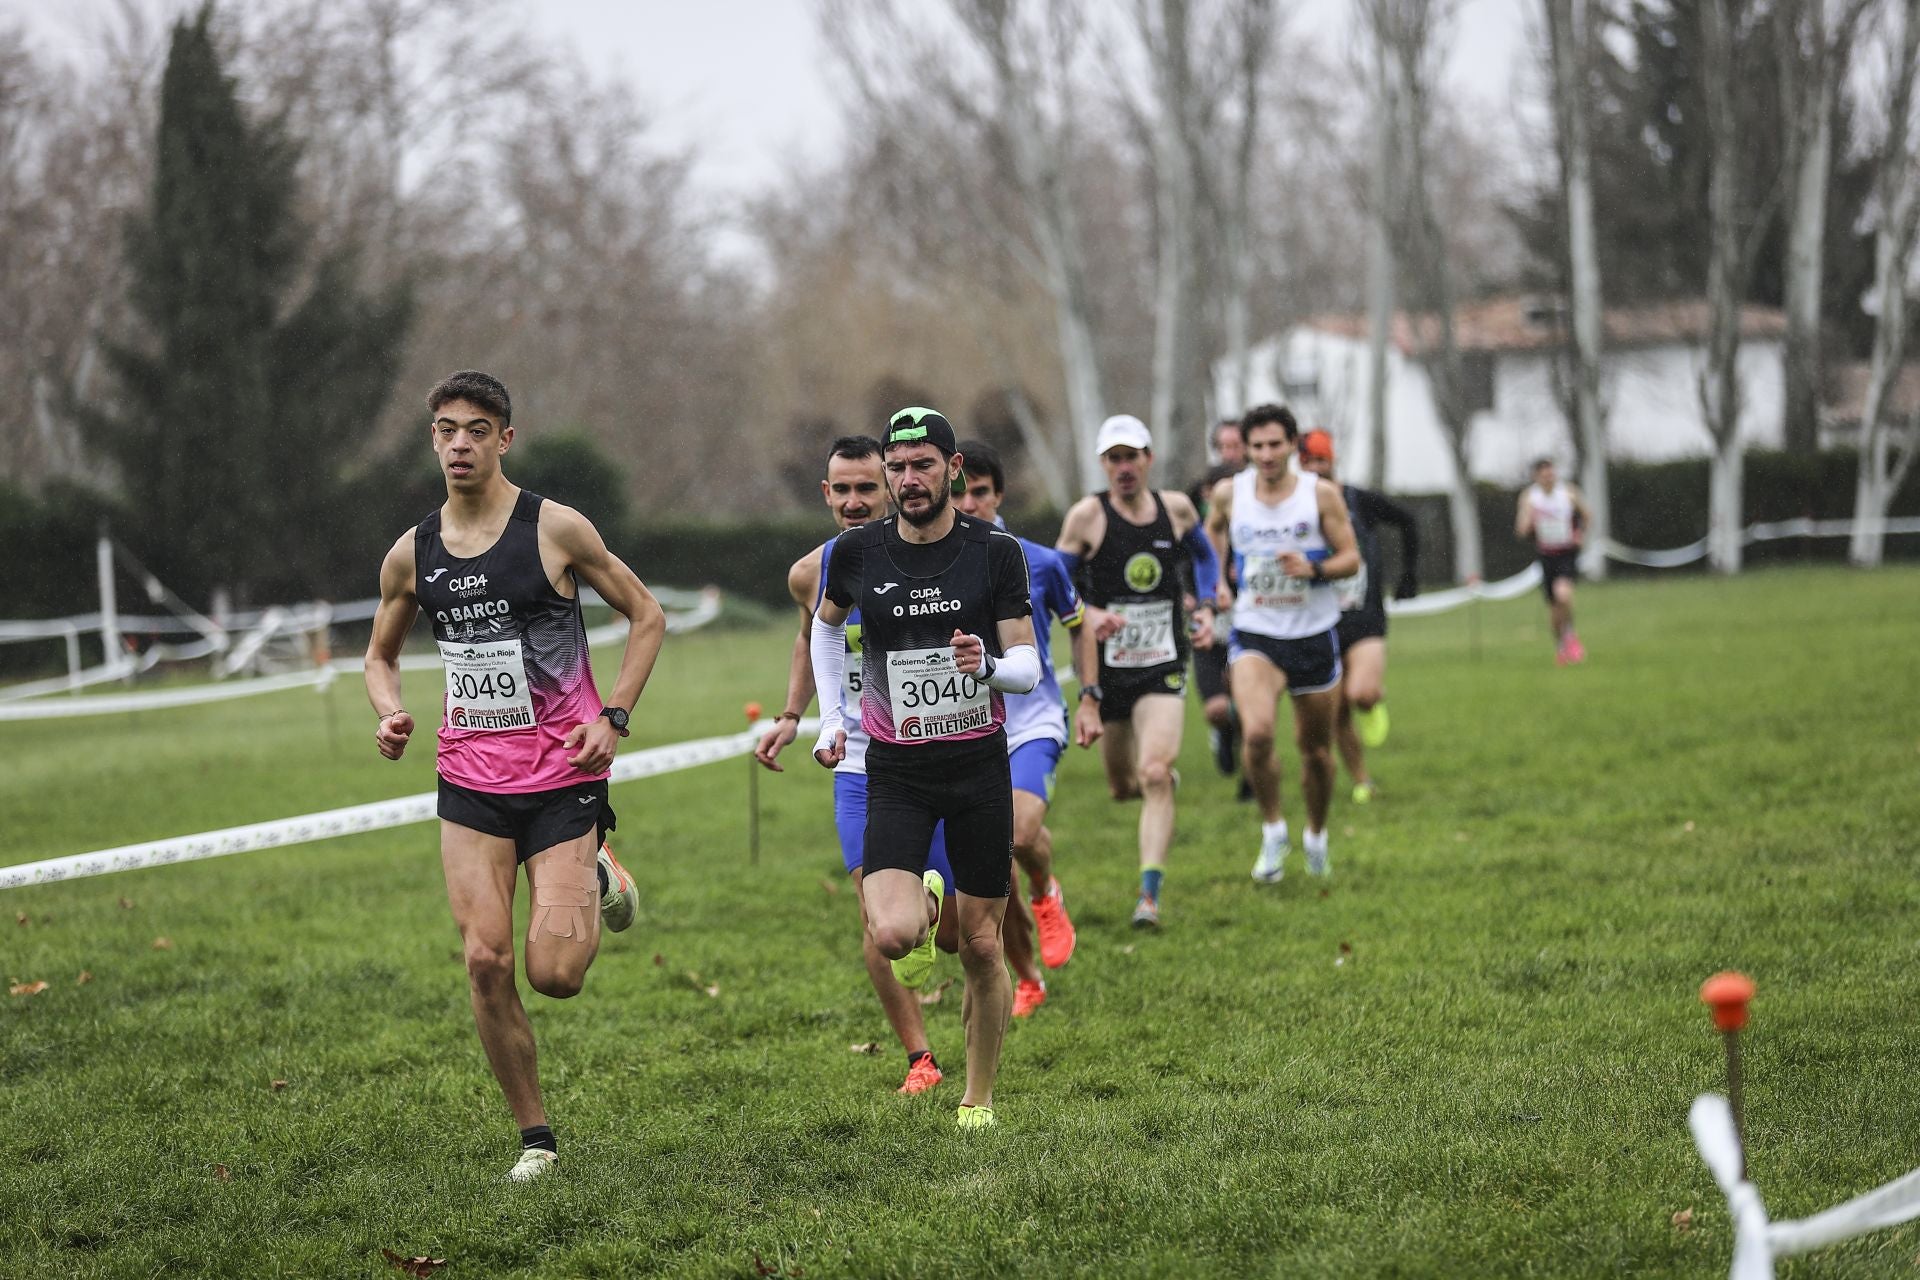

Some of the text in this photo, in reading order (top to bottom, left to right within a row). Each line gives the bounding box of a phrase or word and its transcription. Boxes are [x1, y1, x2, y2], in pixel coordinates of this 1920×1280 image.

[449, 574, 488, 592] CUPA
[910, 587, 942, 599] CUPA
[436, 599, 509, 623] O BARCO
[893, 599, 962, 617] O BARCO
[497, 649, 515, 658] Rioja
[891, 657, 926, 667] Gobierno
[941, 655, 950, 663] de
[451, 672, 516, 700] 3049
[902, 674, 978, 708] 3040
[467, 708, 496, 716] FEDERACIÓN
[496, 706, 519, 715] RIOJANA
[923, 712, 957, 723] FEDERACIÓN
[979, 704, 986, 712] DE
[469, 712, 531, 729] ATLETISMO
[924, 711, 988, 737] ATLETISMO
